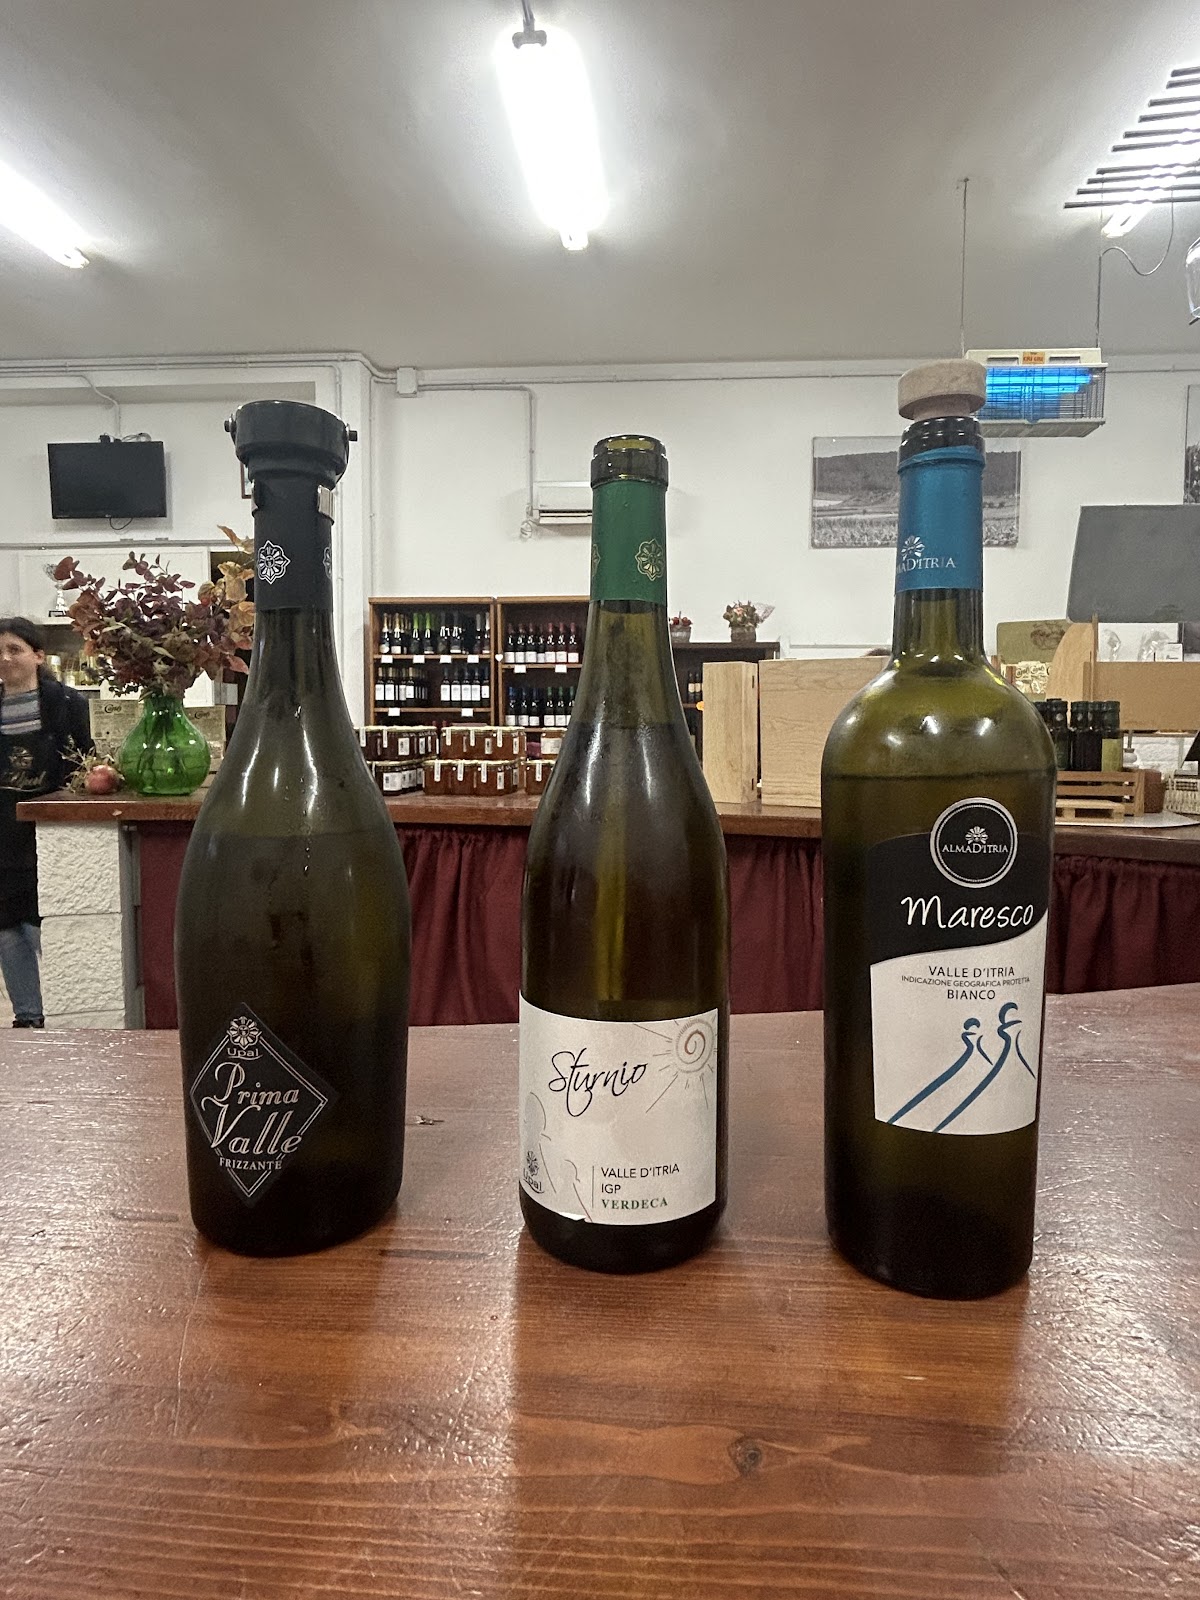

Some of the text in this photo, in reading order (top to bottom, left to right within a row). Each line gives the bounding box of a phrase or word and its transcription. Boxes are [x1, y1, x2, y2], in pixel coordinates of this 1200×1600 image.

[900, 895, 1034, 929] Maresco
[928, 965, 1015, 978] VALLE D'ITRIA
[901, 975, 1030, 988] INDICAZIONE GEOGRAFICA PROTETTA
[947, 989, 996, 1000] BIANCO
[227, 1047, 259, 1059] Upal
[213, 1061, 300, 1106] Prima
[548, 1047, 649, 1117] Sturnio
[201, 1096, 302, 1155] Valle
[219, 1156, 283, 1171] FRIZZANTE
[601, 1163, 680, 1179] VALLE D'ITRIA
[601, 1183, 622, 1194] IGP
[601, 1197, 668, 1210] VERDECA
